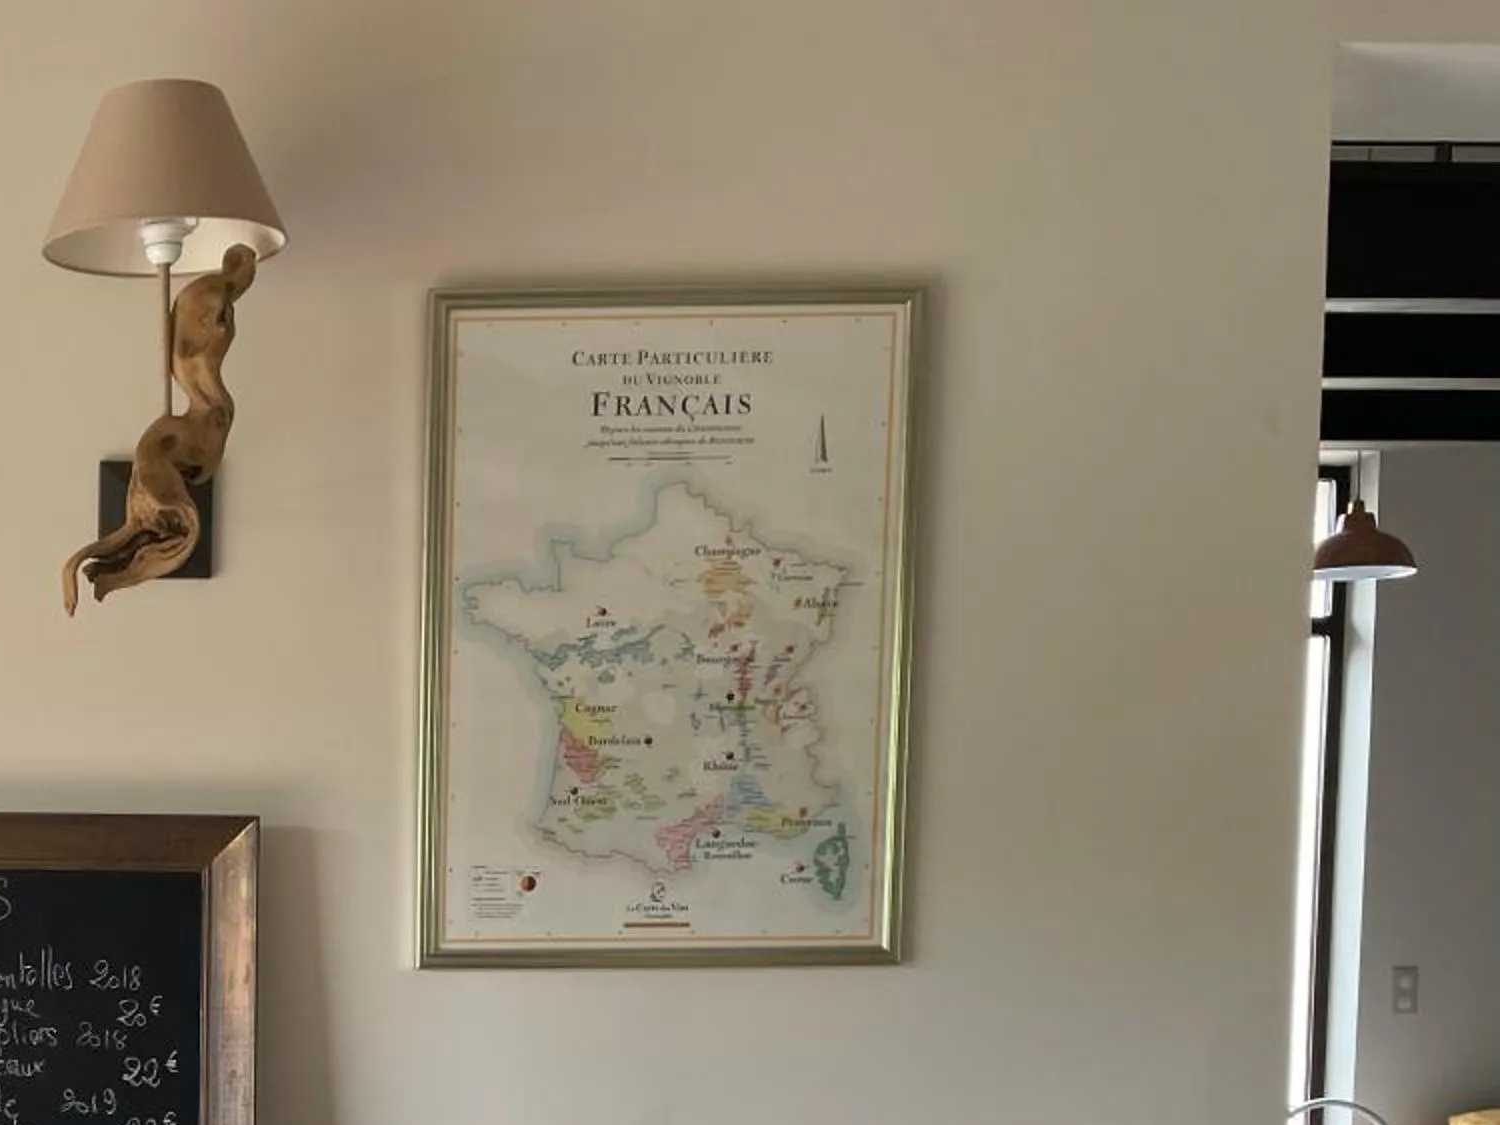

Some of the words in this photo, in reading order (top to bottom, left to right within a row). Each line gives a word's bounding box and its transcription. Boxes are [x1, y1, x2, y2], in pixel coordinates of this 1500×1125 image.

[571, 350, 632, 366] CARTE
[647, 373, 722, 385] VIGNOBLE
[590, 391, 752, 422] FRANÇAIS
[88, 958, 142, 992] 2018
[76, 1021, 129, 1051] 2018
[60, 1087, 118, 1116] 2019
